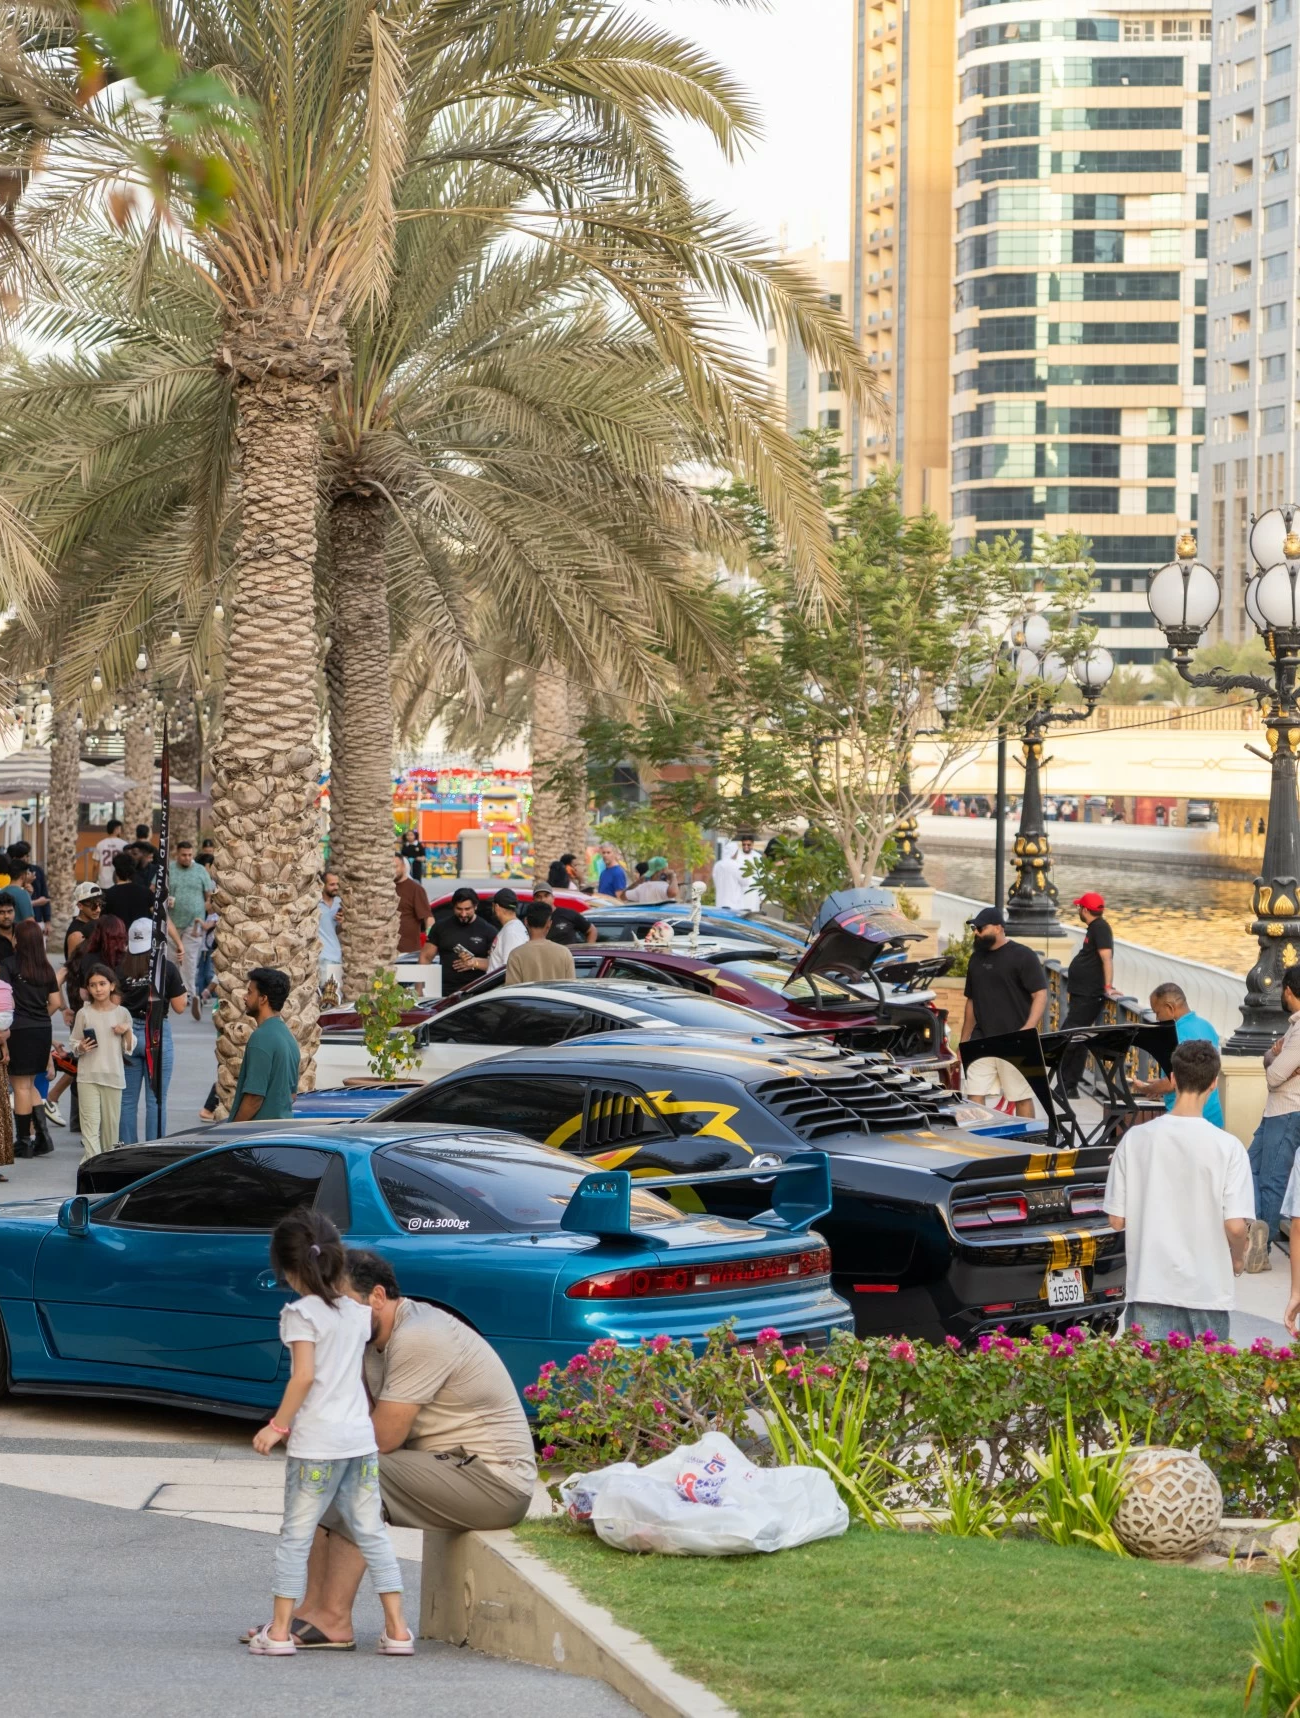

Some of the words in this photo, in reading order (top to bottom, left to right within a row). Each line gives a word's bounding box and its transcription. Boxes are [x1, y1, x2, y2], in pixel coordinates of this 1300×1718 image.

[159, 800, 168, 859] UNITED
[1029, 1202, 1065, 1210] DODGE
[423, 1218, 470, 1230] dr.3000gt
[710, 1266, 787, 1283] MITSUBISHI
[1053, 1284, 1079, 1303] 15359
